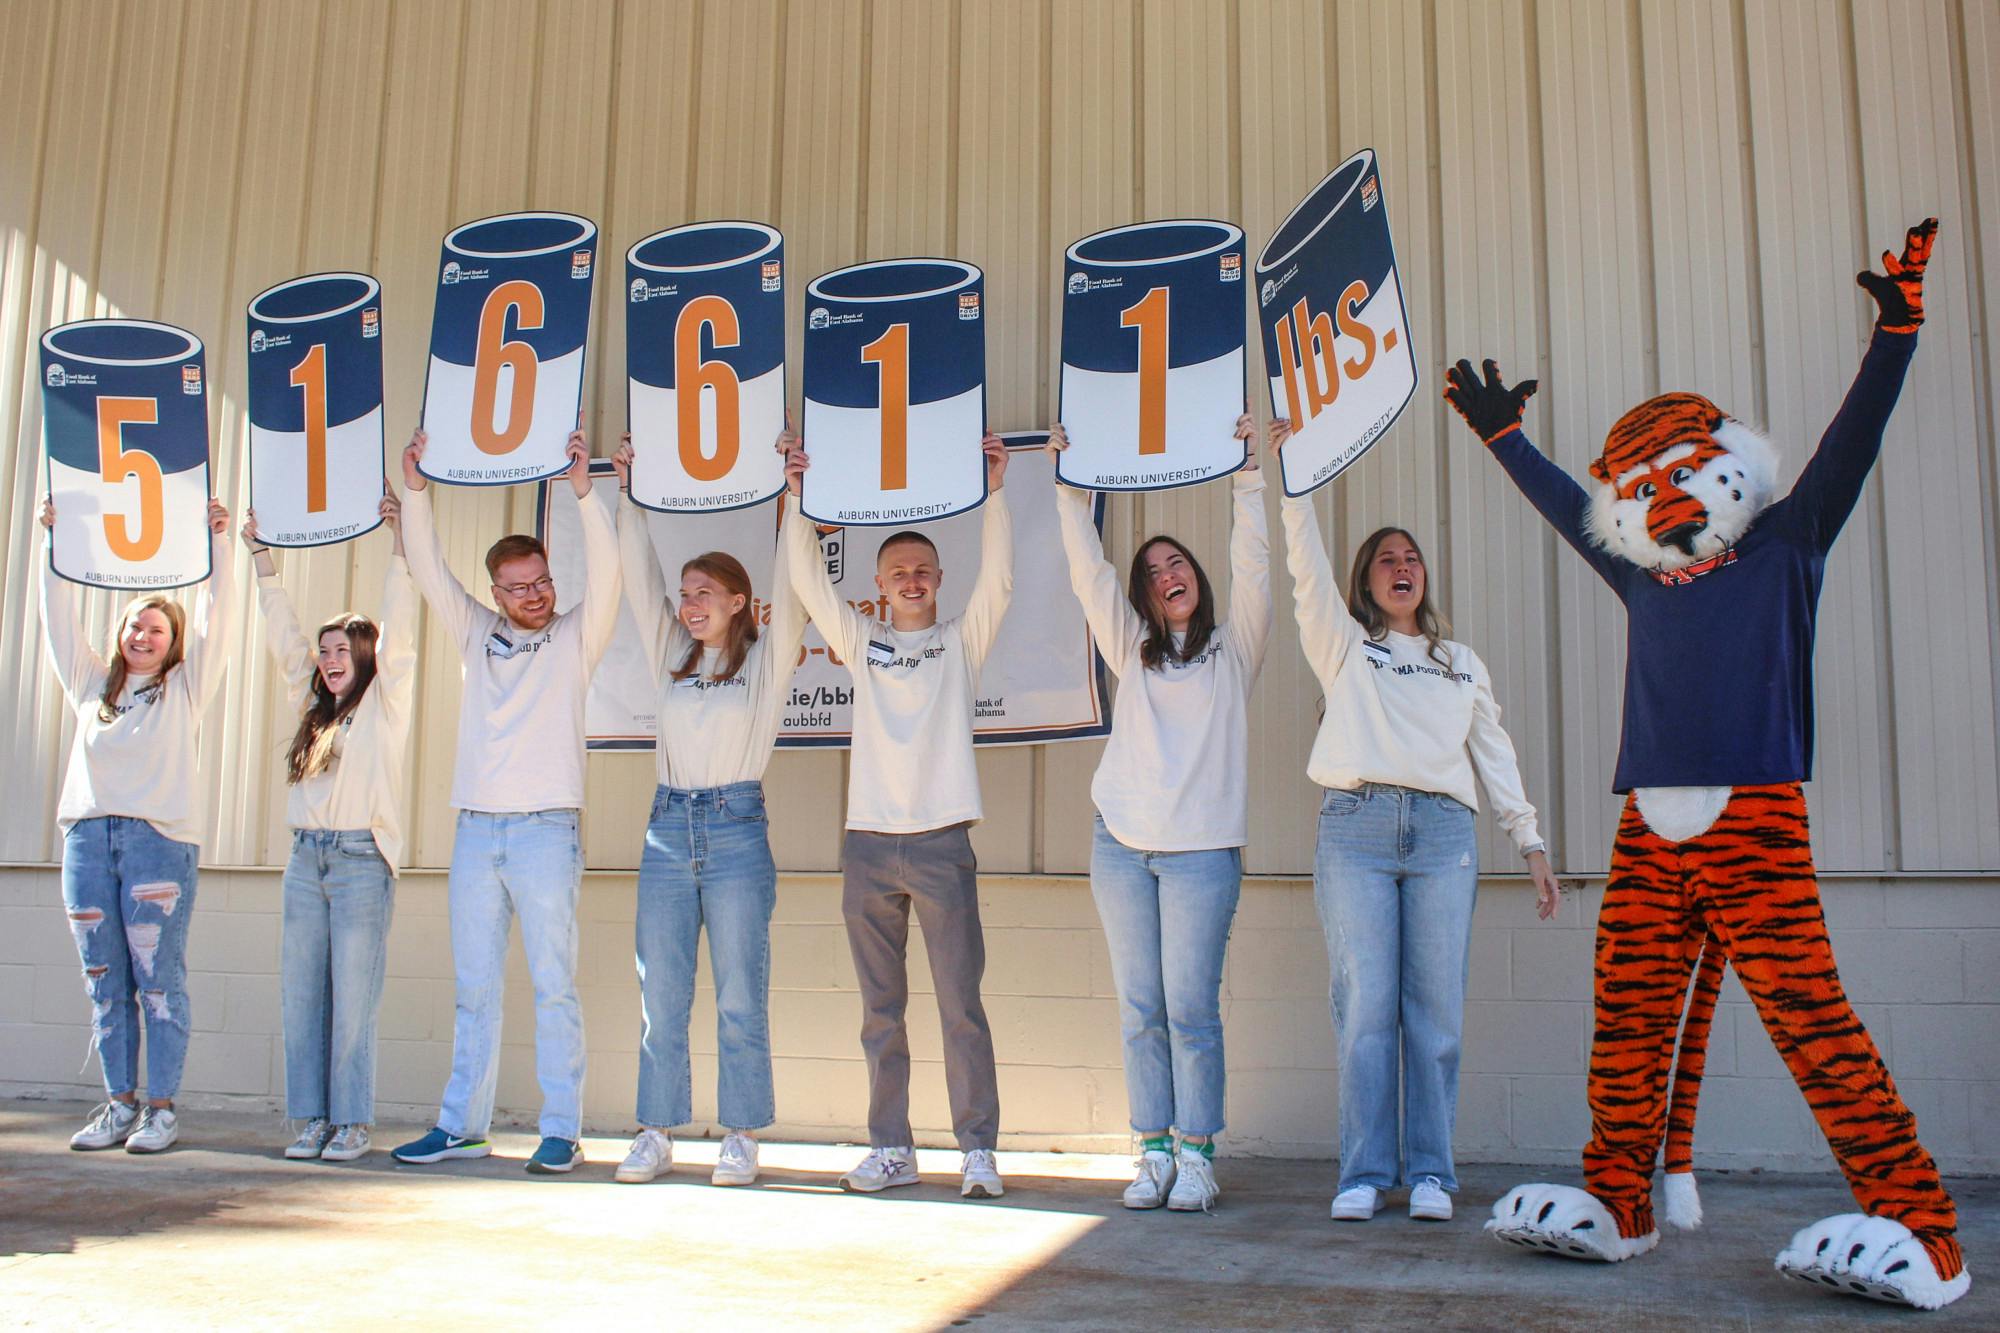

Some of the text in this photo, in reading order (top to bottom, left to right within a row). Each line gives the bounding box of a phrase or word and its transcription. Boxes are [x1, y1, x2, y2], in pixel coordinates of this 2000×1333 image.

[1275, 280, 1398, 435] lbs.
[470, 280, 545, 456] 6
[1120, 286, 1170, 456] 1
[674, 295, 741, 482] 6
[861, 322, 910, 491] 1
[289, 343, 327, 514] 1
[447, 468, 482, 479] AUBURN
[1313, 454, 1343, 483] AUBURN
[96, 395, 165, 563] 5
[1095, 475, 1137, 485] AUBURN
[661, 496, 696, 507] AUBURN
[838, 510, 879, 520] AUBURN
[276, 533, 307, 542] AUBURN
[85, 572, 121, 583] AUBURN
[1415, 664, 1440, 676] FOOD
[994, 697, 1004, 707] of
[975, 707, 1006, 717] labama
[783, 712, 831, 727] aubbfd
